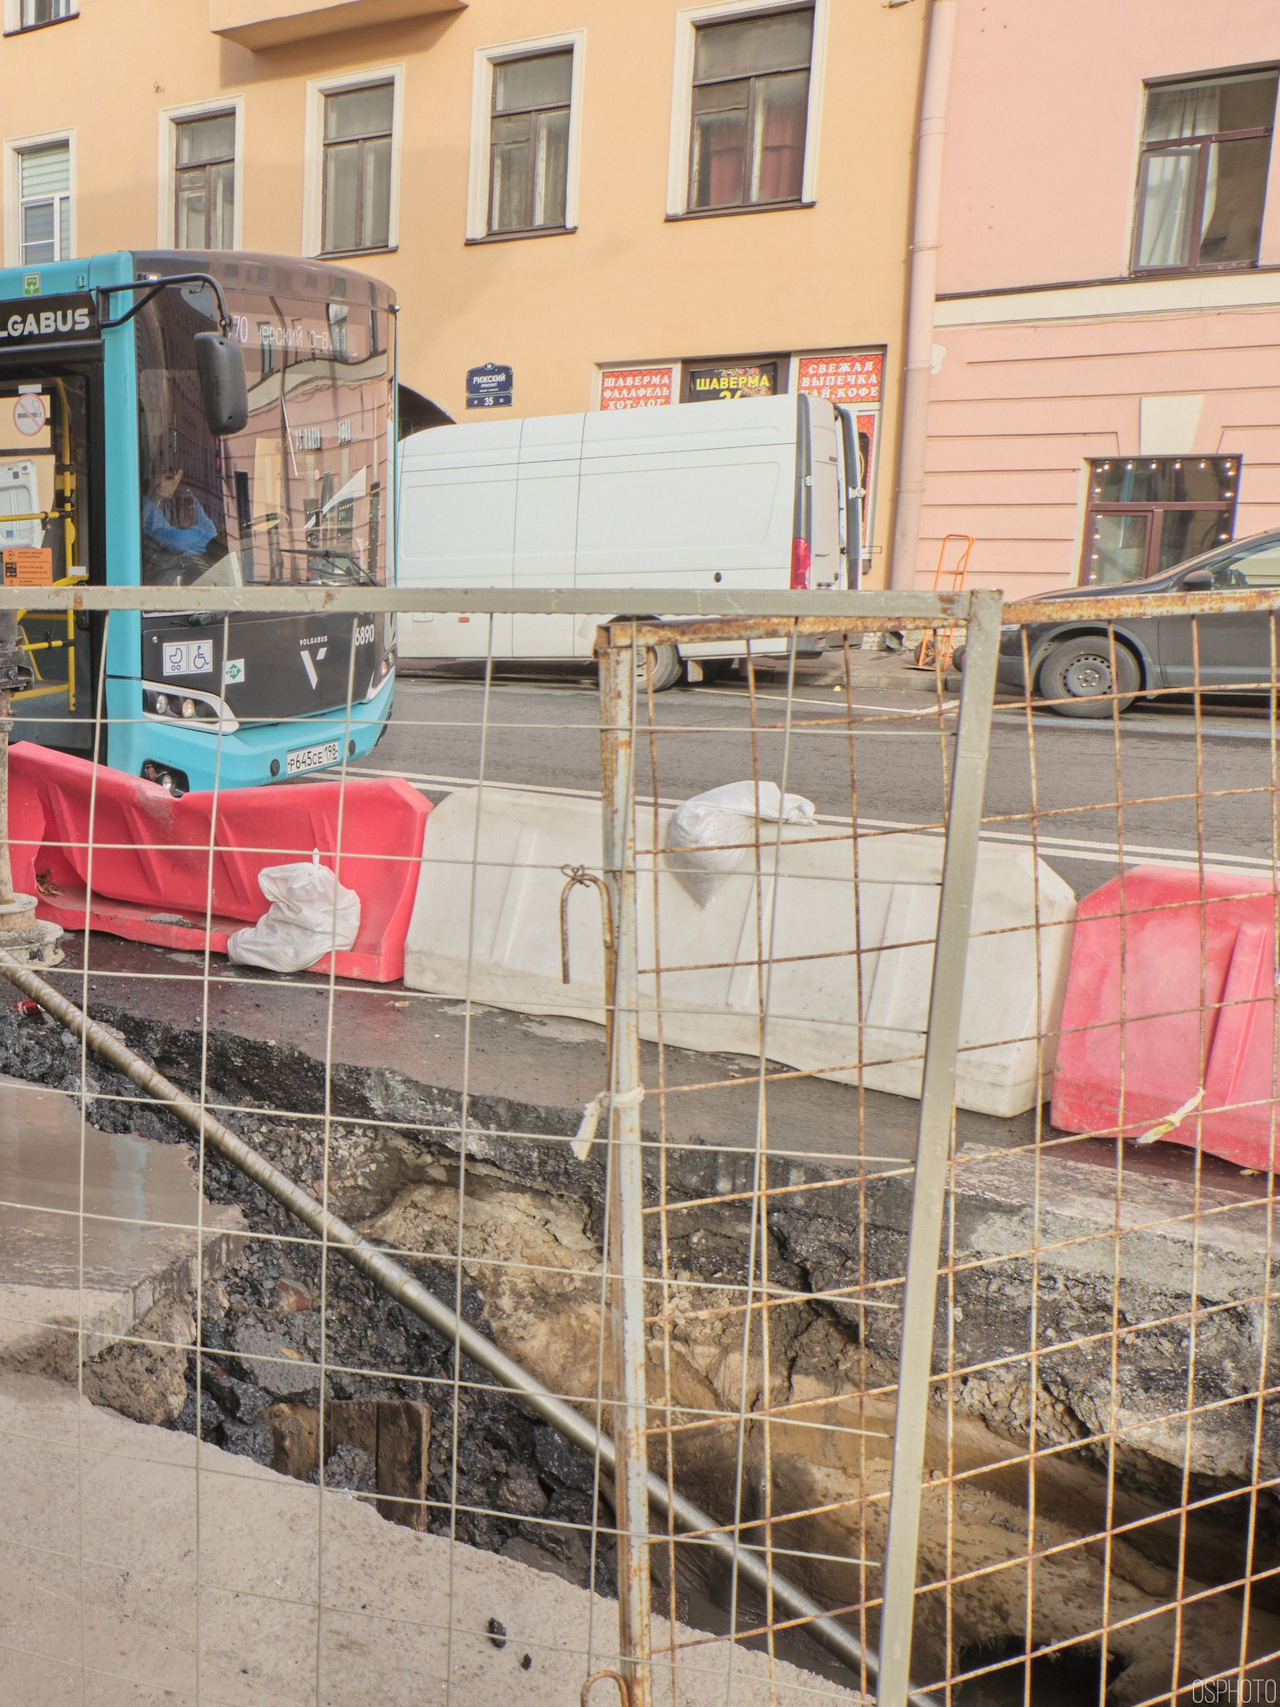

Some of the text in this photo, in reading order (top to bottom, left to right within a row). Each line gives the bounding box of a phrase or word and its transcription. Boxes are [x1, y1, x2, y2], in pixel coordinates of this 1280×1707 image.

[233, 316, 248, 343] 70
[808, 361, 874, 375] СВЕЖАЯ
[472, 372, 506, 385] РИЖСКИЙ
[603, 375, 670, 387] ШАВЕРМА
[696, 374, 770, 391] ШАВЕРМА
[801, 374, 878, 387] ВЫПЕЧКА
[603, 387, 670, 399] ФАЛАФЕЛЬ
[484, 396, 494, 406] 35
[299, 635, 328, 646] VOLGABUS
[355, 623, 375, 647] 6890
[289, 750, 323, 771] Р645СЕ
